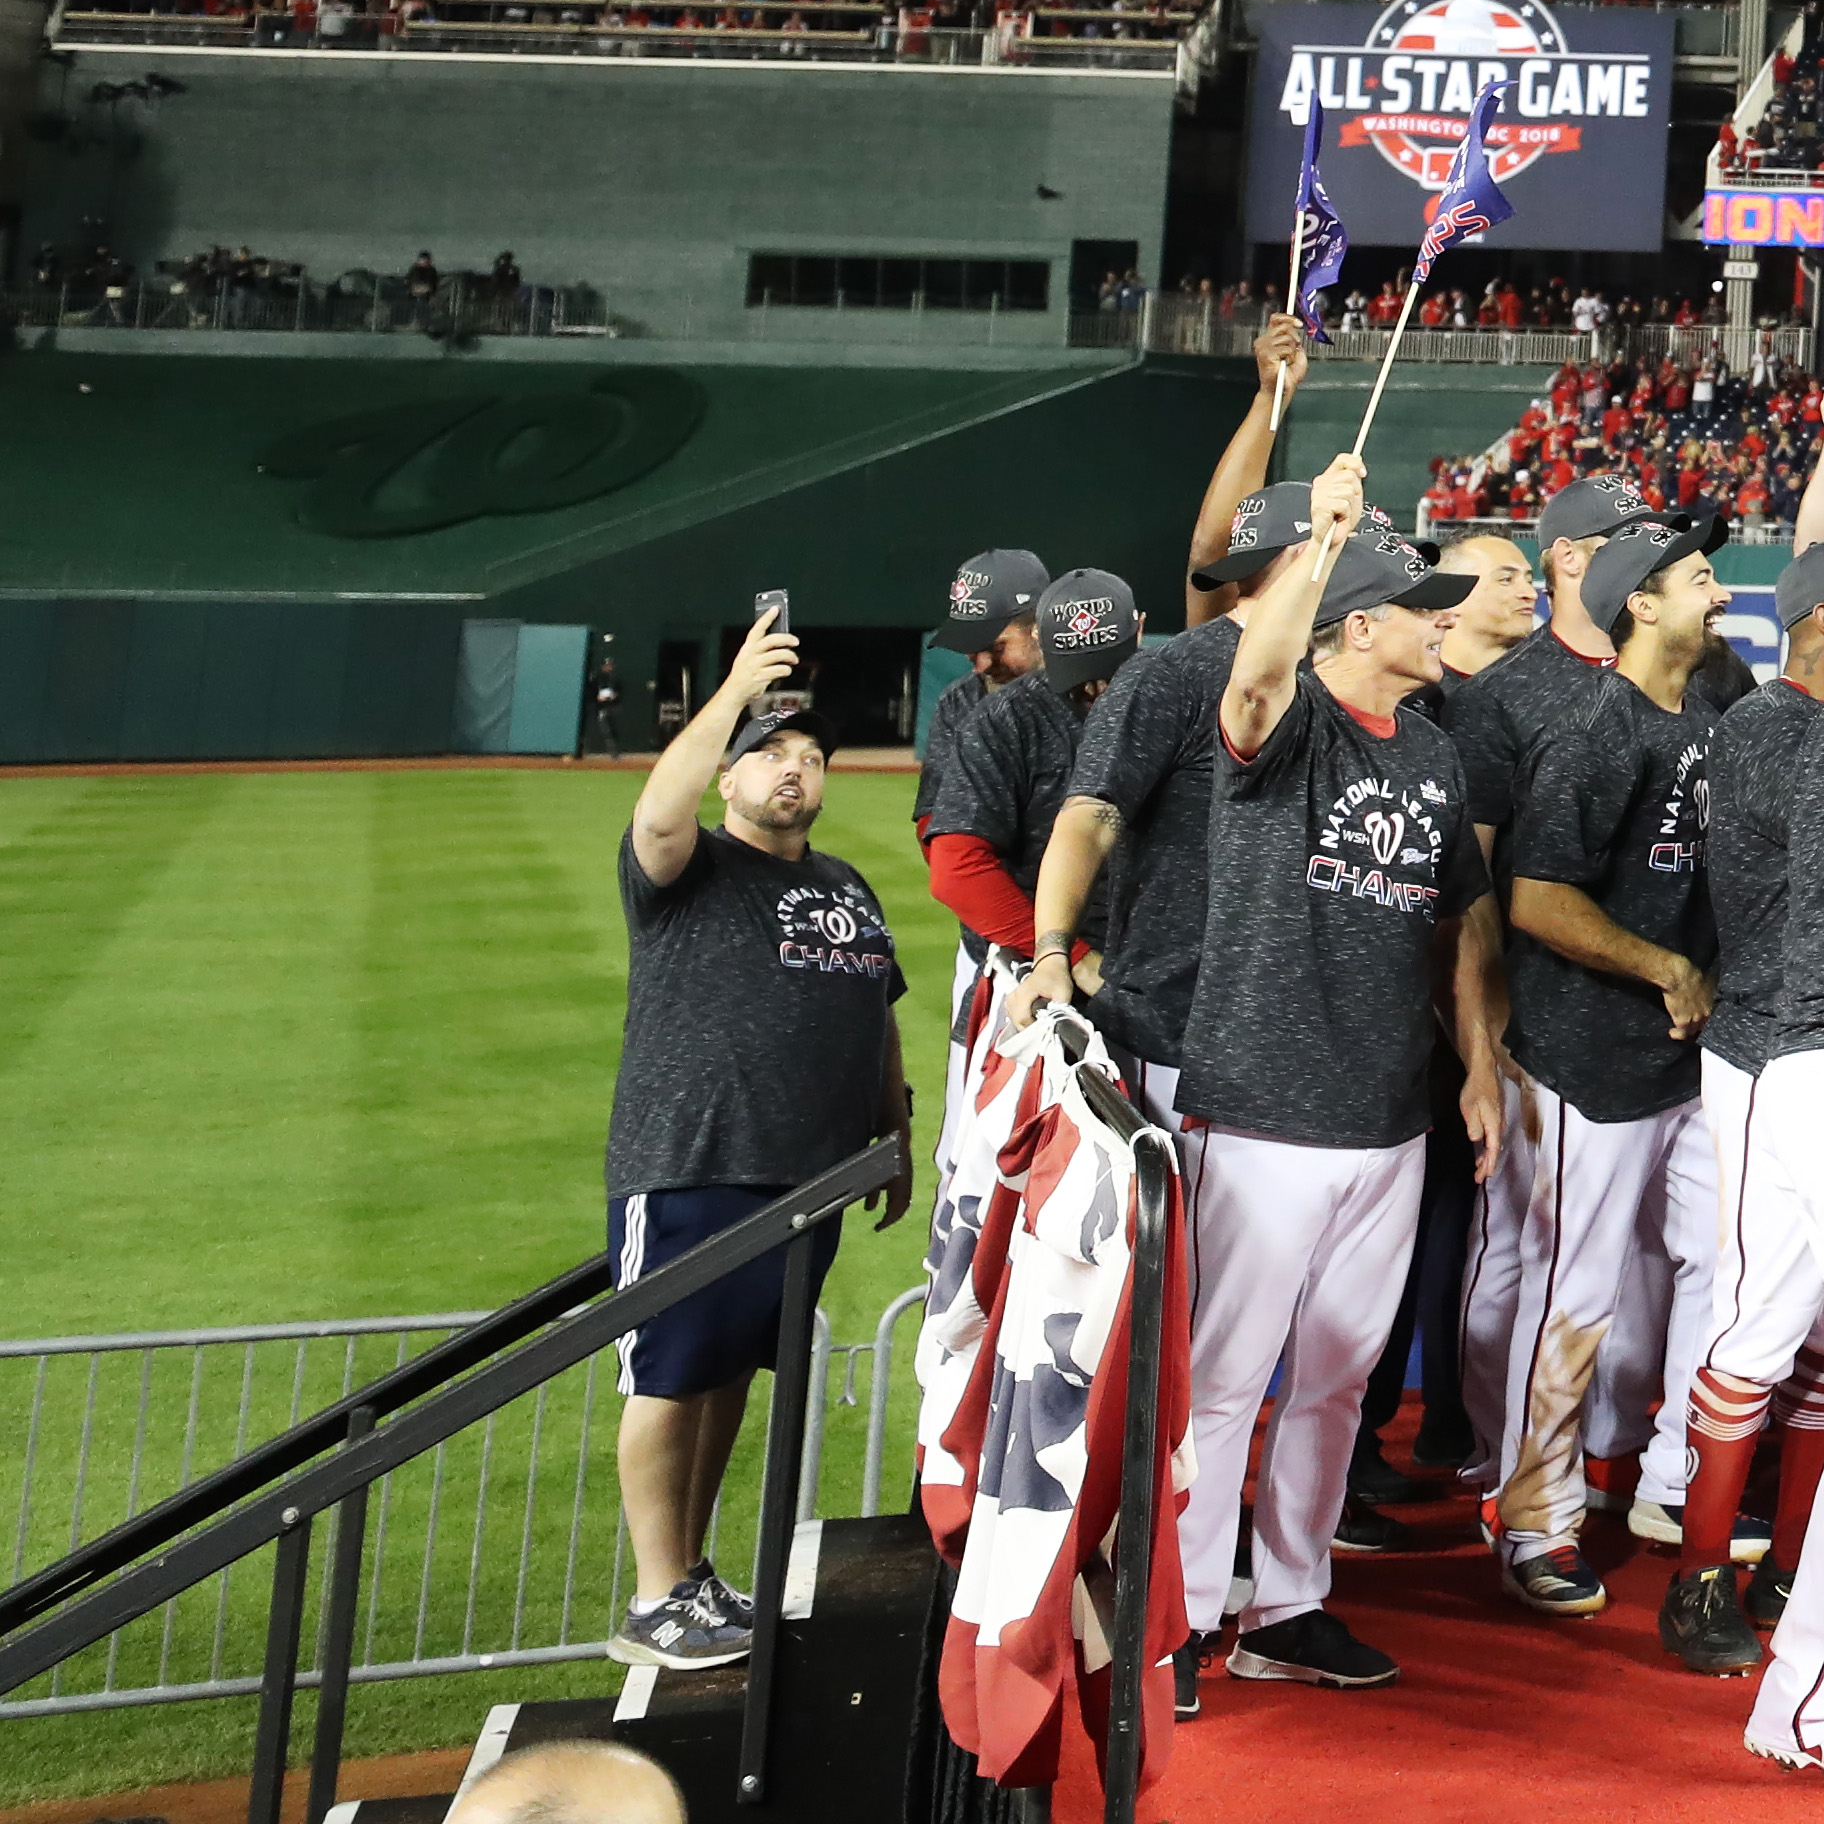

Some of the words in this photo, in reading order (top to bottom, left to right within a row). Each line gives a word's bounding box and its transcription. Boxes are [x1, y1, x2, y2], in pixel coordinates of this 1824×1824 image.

[1518, 60, 1651, 118] GAME
[1363, 116, 1474, 142] WASHINGTO
[1485, 127, 1509, 143] DC
[1519, 128, 1562, 143] 2018
[1049, 597, 1117, 622] WORLD
[1053, 625, 1121, 651] SERIES
